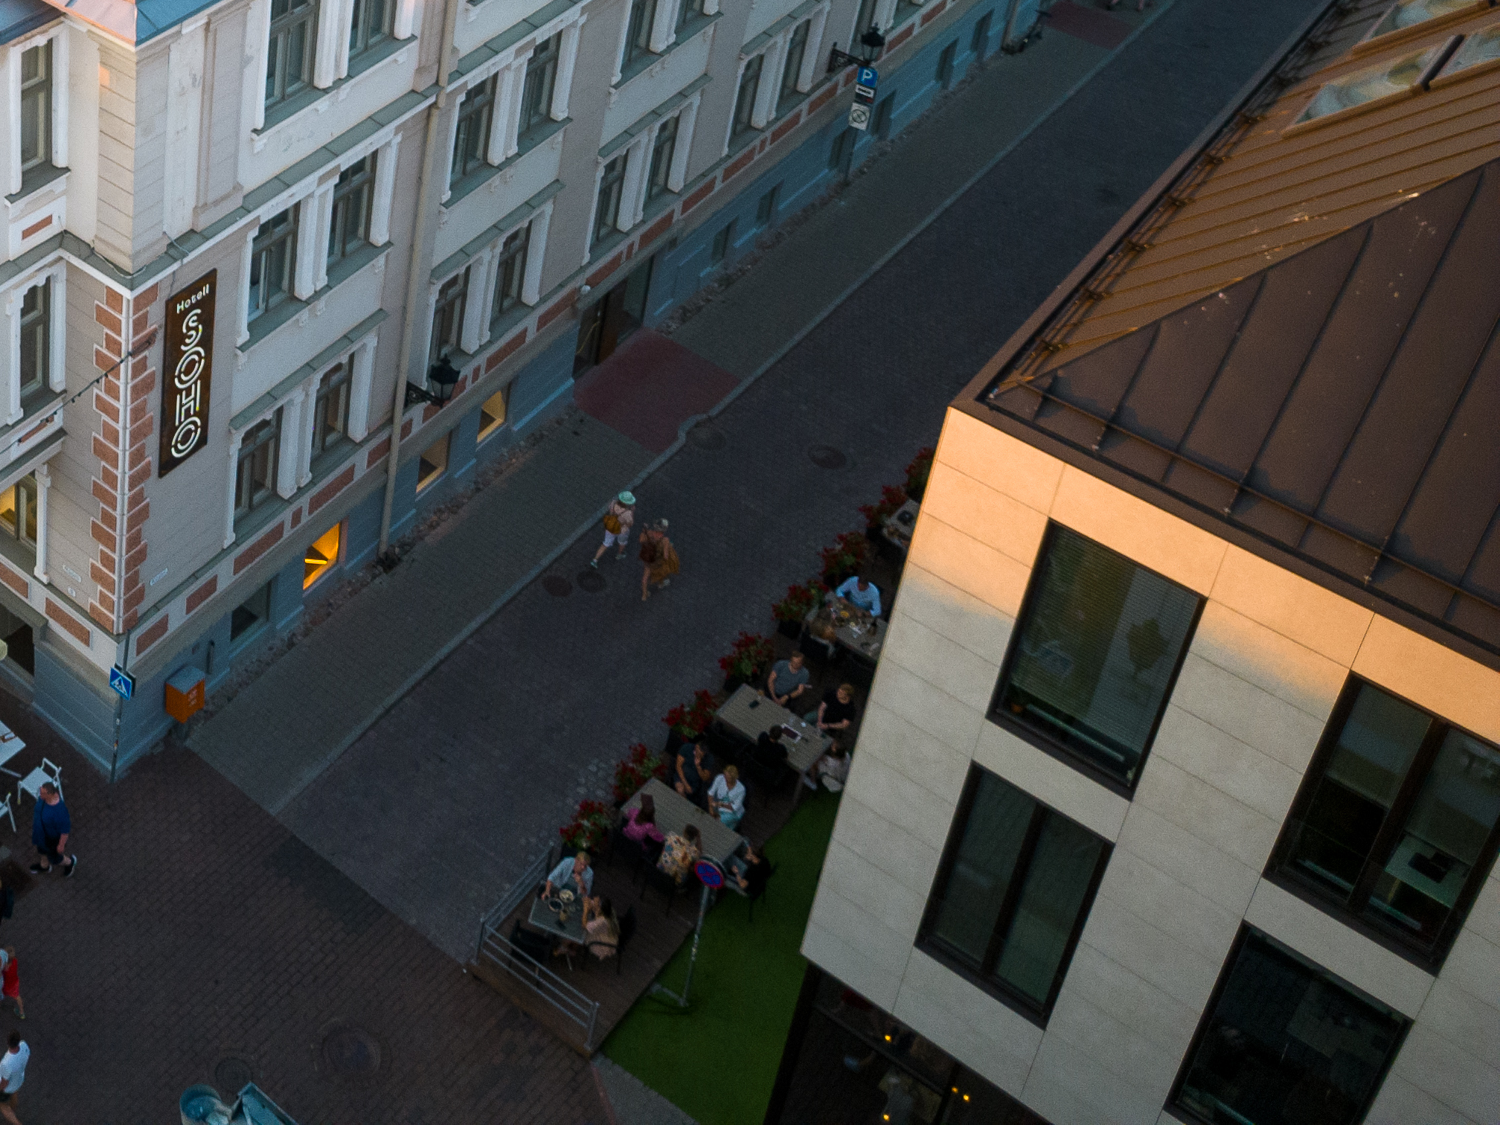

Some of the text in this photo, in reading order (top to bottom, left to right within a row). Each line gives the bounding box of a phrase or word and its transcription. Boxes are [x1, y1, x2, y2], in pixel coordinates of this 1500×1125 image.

[861, 69, 873, 81] P
[176, 283, 210, 314] Hotell
[171, 309, 205, 458] SOHO
